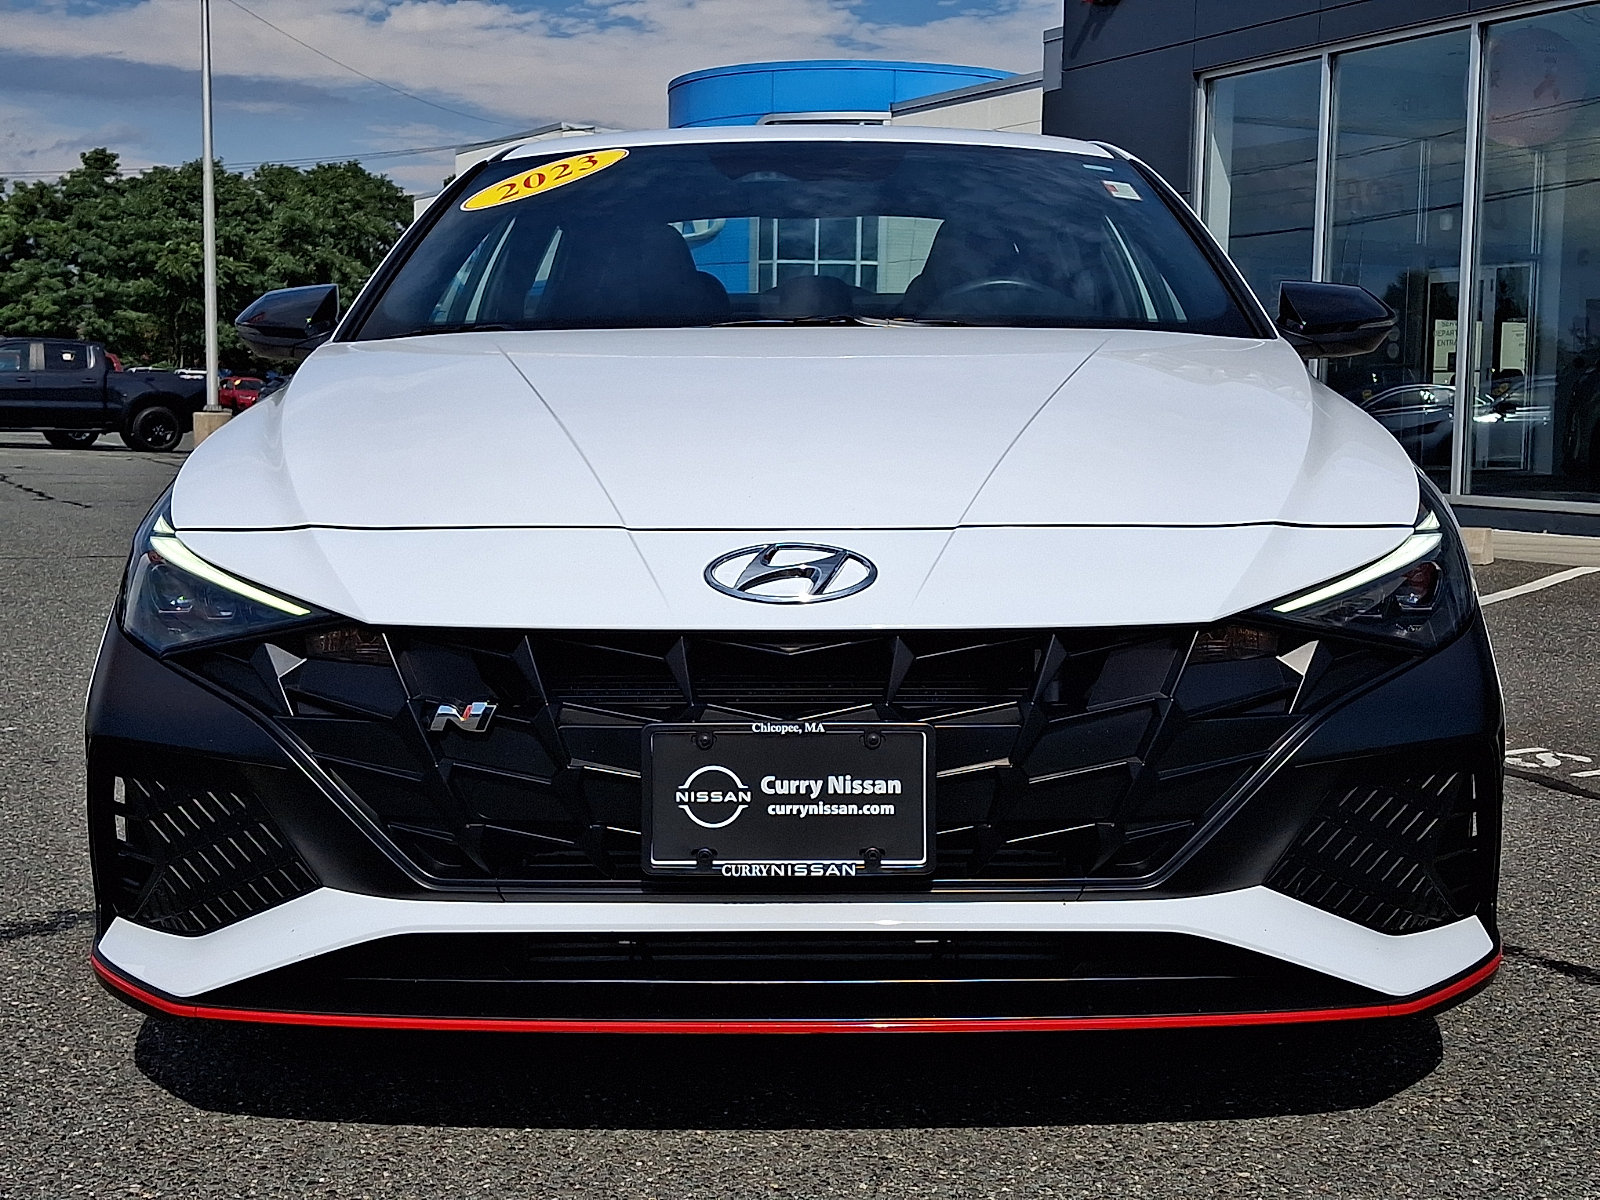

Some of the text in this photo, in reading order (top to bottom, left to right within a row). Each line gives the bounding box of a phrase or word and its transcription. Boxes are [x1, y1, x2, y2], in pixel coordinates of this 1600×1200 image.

[496, 155, 598, 201] 2023
[752, 722, 826, 735] Chicopee, MA
[760, 774, 902, 799] Curry Nissan
[675, 791, 751, 803] NISSAN
[767, 801, 895, 818] currynissan.com
